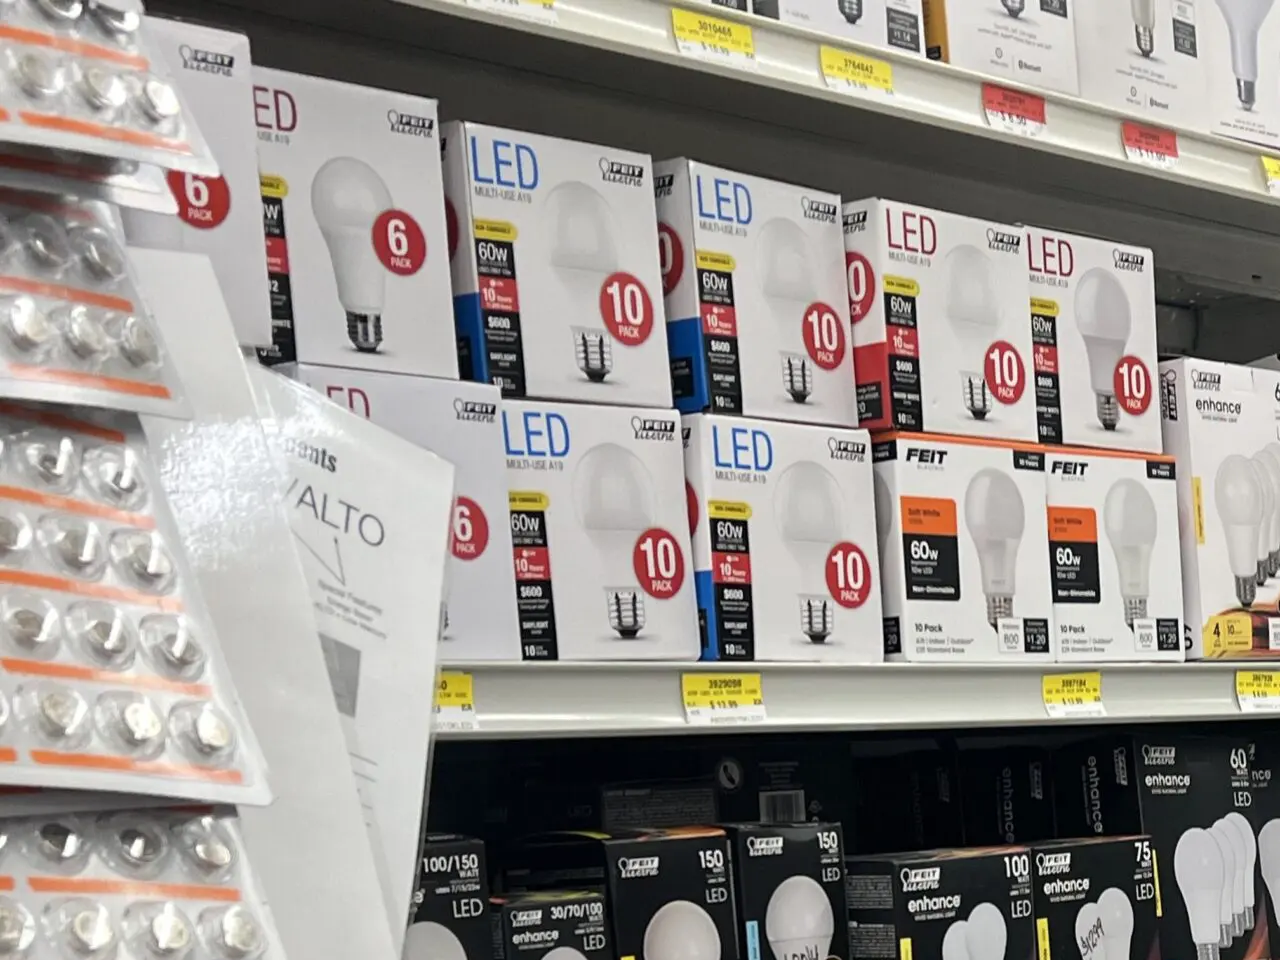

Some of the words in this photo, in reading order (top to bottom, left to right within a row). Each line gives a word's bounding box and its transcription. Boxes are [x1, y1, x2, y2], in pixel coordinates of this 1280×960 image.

[470, 136, 539, 190] LED
[474, 186, 516, 202] MULTI-USE
[696, 175, 753, 225] LED
[188, 207, 213, 221] PACK
[386, 219, 409, 256] 6
[886, 208, 937, 255] LED
[390, 255, 412, 269] PACK
[1027, 233, 1074, 277] LED
[607, 282, 644, 325] 10
[618, 324, 639, 338] PACK
[808, 310, 838, 351] 10
[817, 350, 835, 363] PACK
[990, 348, 1018, 387] 10
[1119, 363, 1144, 399] 10
[997, 386, 1015, 399] PACK
[1126, 397, 1142, 409] PACK
[502, 410, 570, 457] LED
[712, 425, 773, 471] LED
[906, 448, 948, 464] FEIT
[1051, 462, 1088, 476] FEIT
[640, 538, 676, 579] 10
[832, 551, 863, 589] 10
[651, 580, 672, 592] PACK
[912, 586, 955, 595] Non-Dimmable
[1058, 590, 1096, 598] Non-Dimmable
[840, 590, 859, 601] PACK
[915, 624, 923, 633] 10
[924, 623, 943, 634] Pack
[1060, 625, 1068, 633] 10
[1069, 625, 1085, 634] Pack
[1230, 749, 1246, 770] 60
[1145, 774, 1190, 786] enhance
[1233, 791, 1251, 807] LED
[817, 832, 838, 849] 150
[699, 851, 724, 869] 150
[1134, 842, 1151, 861] 75
[822, 867, 841, 882] LED
[1004, 856, 1029, 877] 100
[1044, 878, 1090, 895] enhance
[1136, 883, 1154, 900] LED
[706, 888, 728, 904] LED
[908, 894, 961, 913] enhance
[453, 900, 483, 918] LED
[550, 904, 603, 920] 30/70/100
[1011, 900, 1031, 918] LED
[512, 931, 559, 945] enhance
[584, 935, 606, 951] LED
